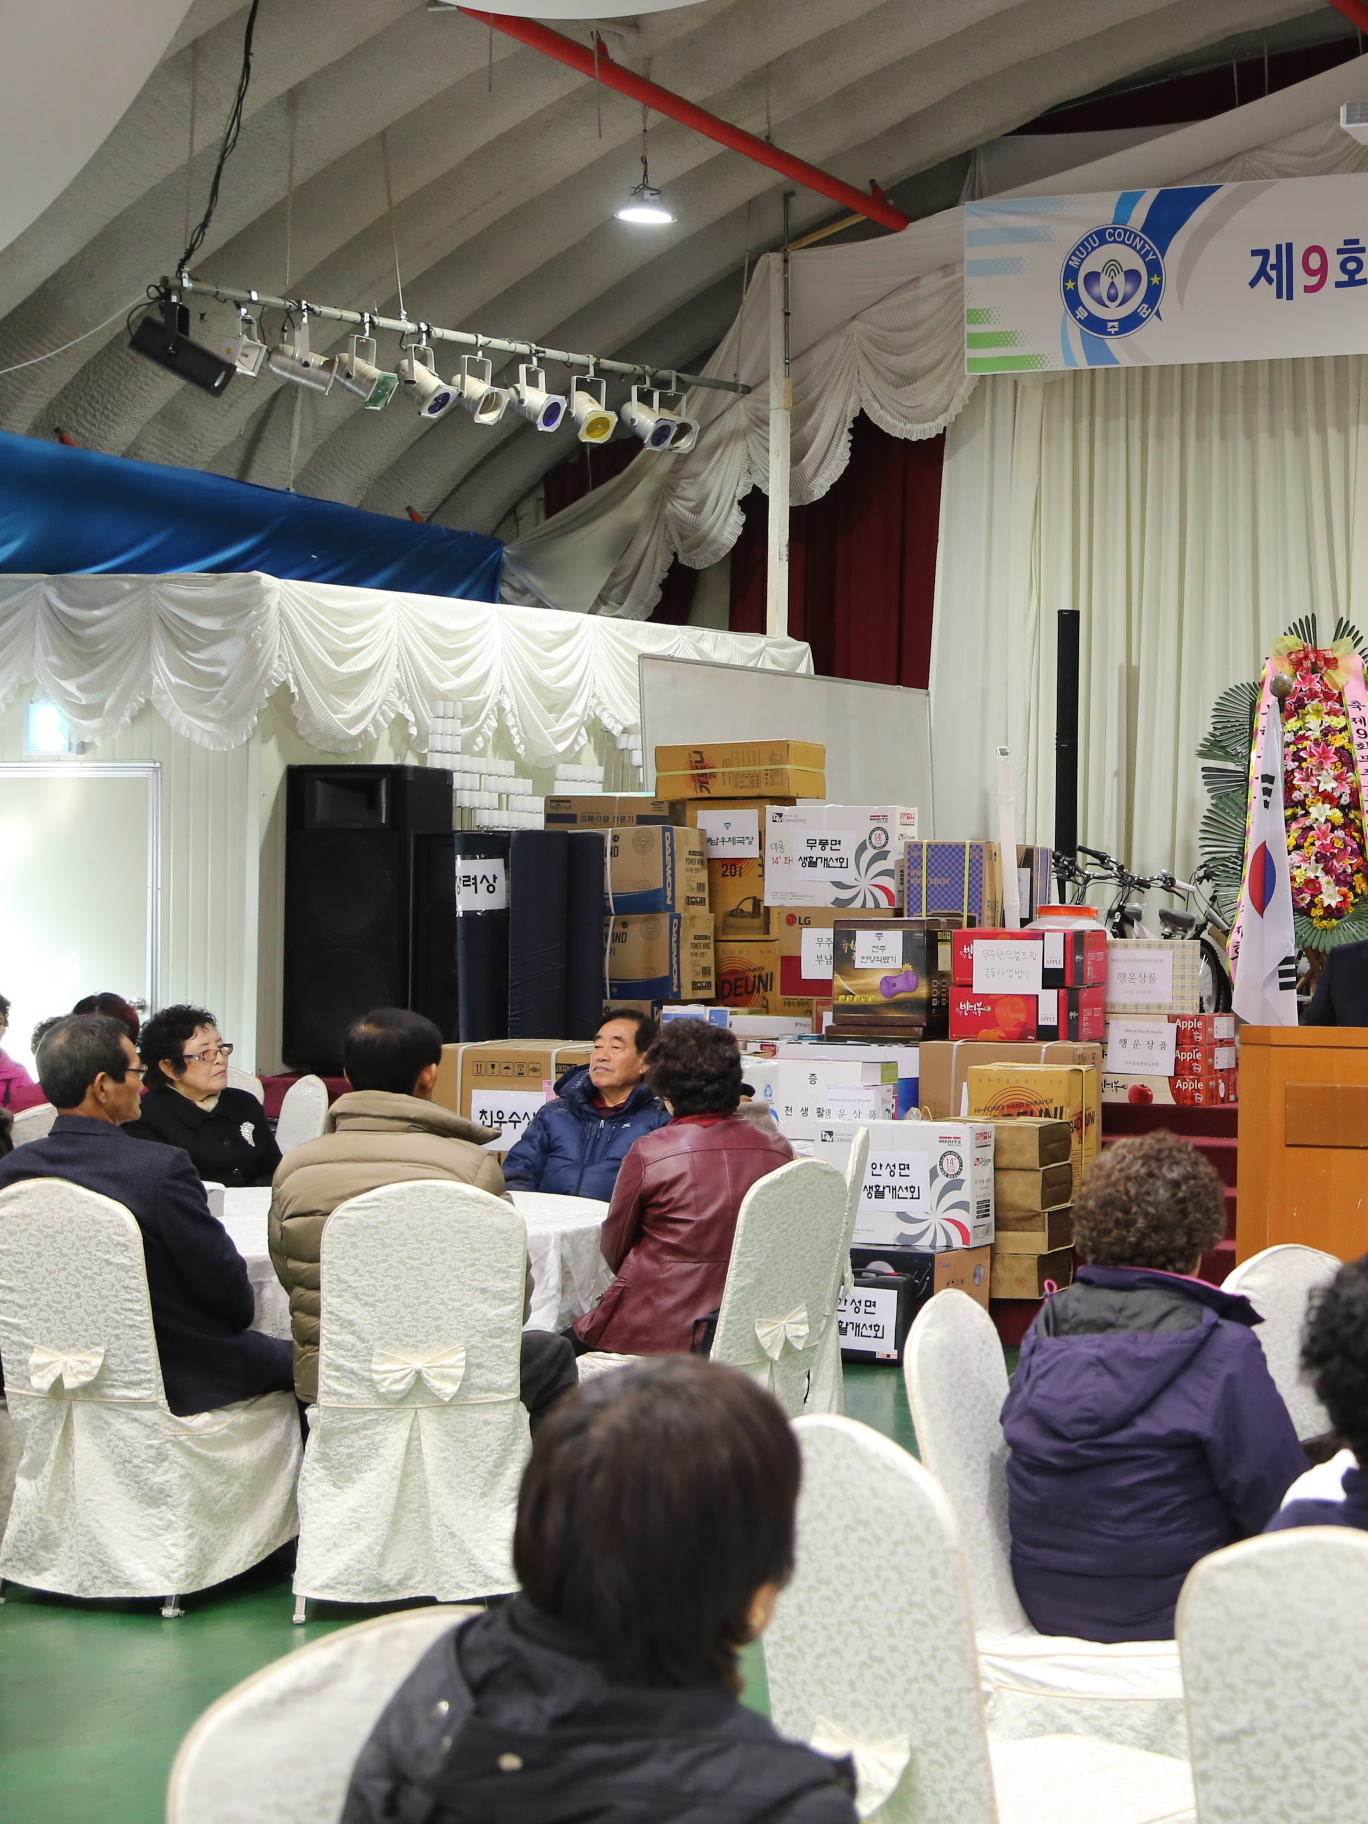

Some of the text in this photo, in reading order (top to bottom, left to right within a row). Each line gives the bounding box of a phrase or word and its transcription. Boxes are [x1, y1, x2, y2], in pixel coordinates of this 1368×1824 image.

[1068, 229, 1157, 268] MUJU COUNTY
[1075, 303, 1152, 334] 무주군
[806, 838, 842, 852] 무풍면
[797, 855, 849, 869] 생활개선회
[797, 916, 812, 926] LG
[1045, 958, 1062, 966] APPLE
[1116, 972, 1158, 984] 행운상품
[1175, 1018, 1203, 1030] Apple
[1175, 1049, 1202, 1061] Apple
[1175, 1079, 1204, 1091] Apple
[1025, 1098, 1054, 1108] SPRAYER
[870, 1162, 911, 1178] 안성면
[862, 1184, 921, 1200] 생활개선회
